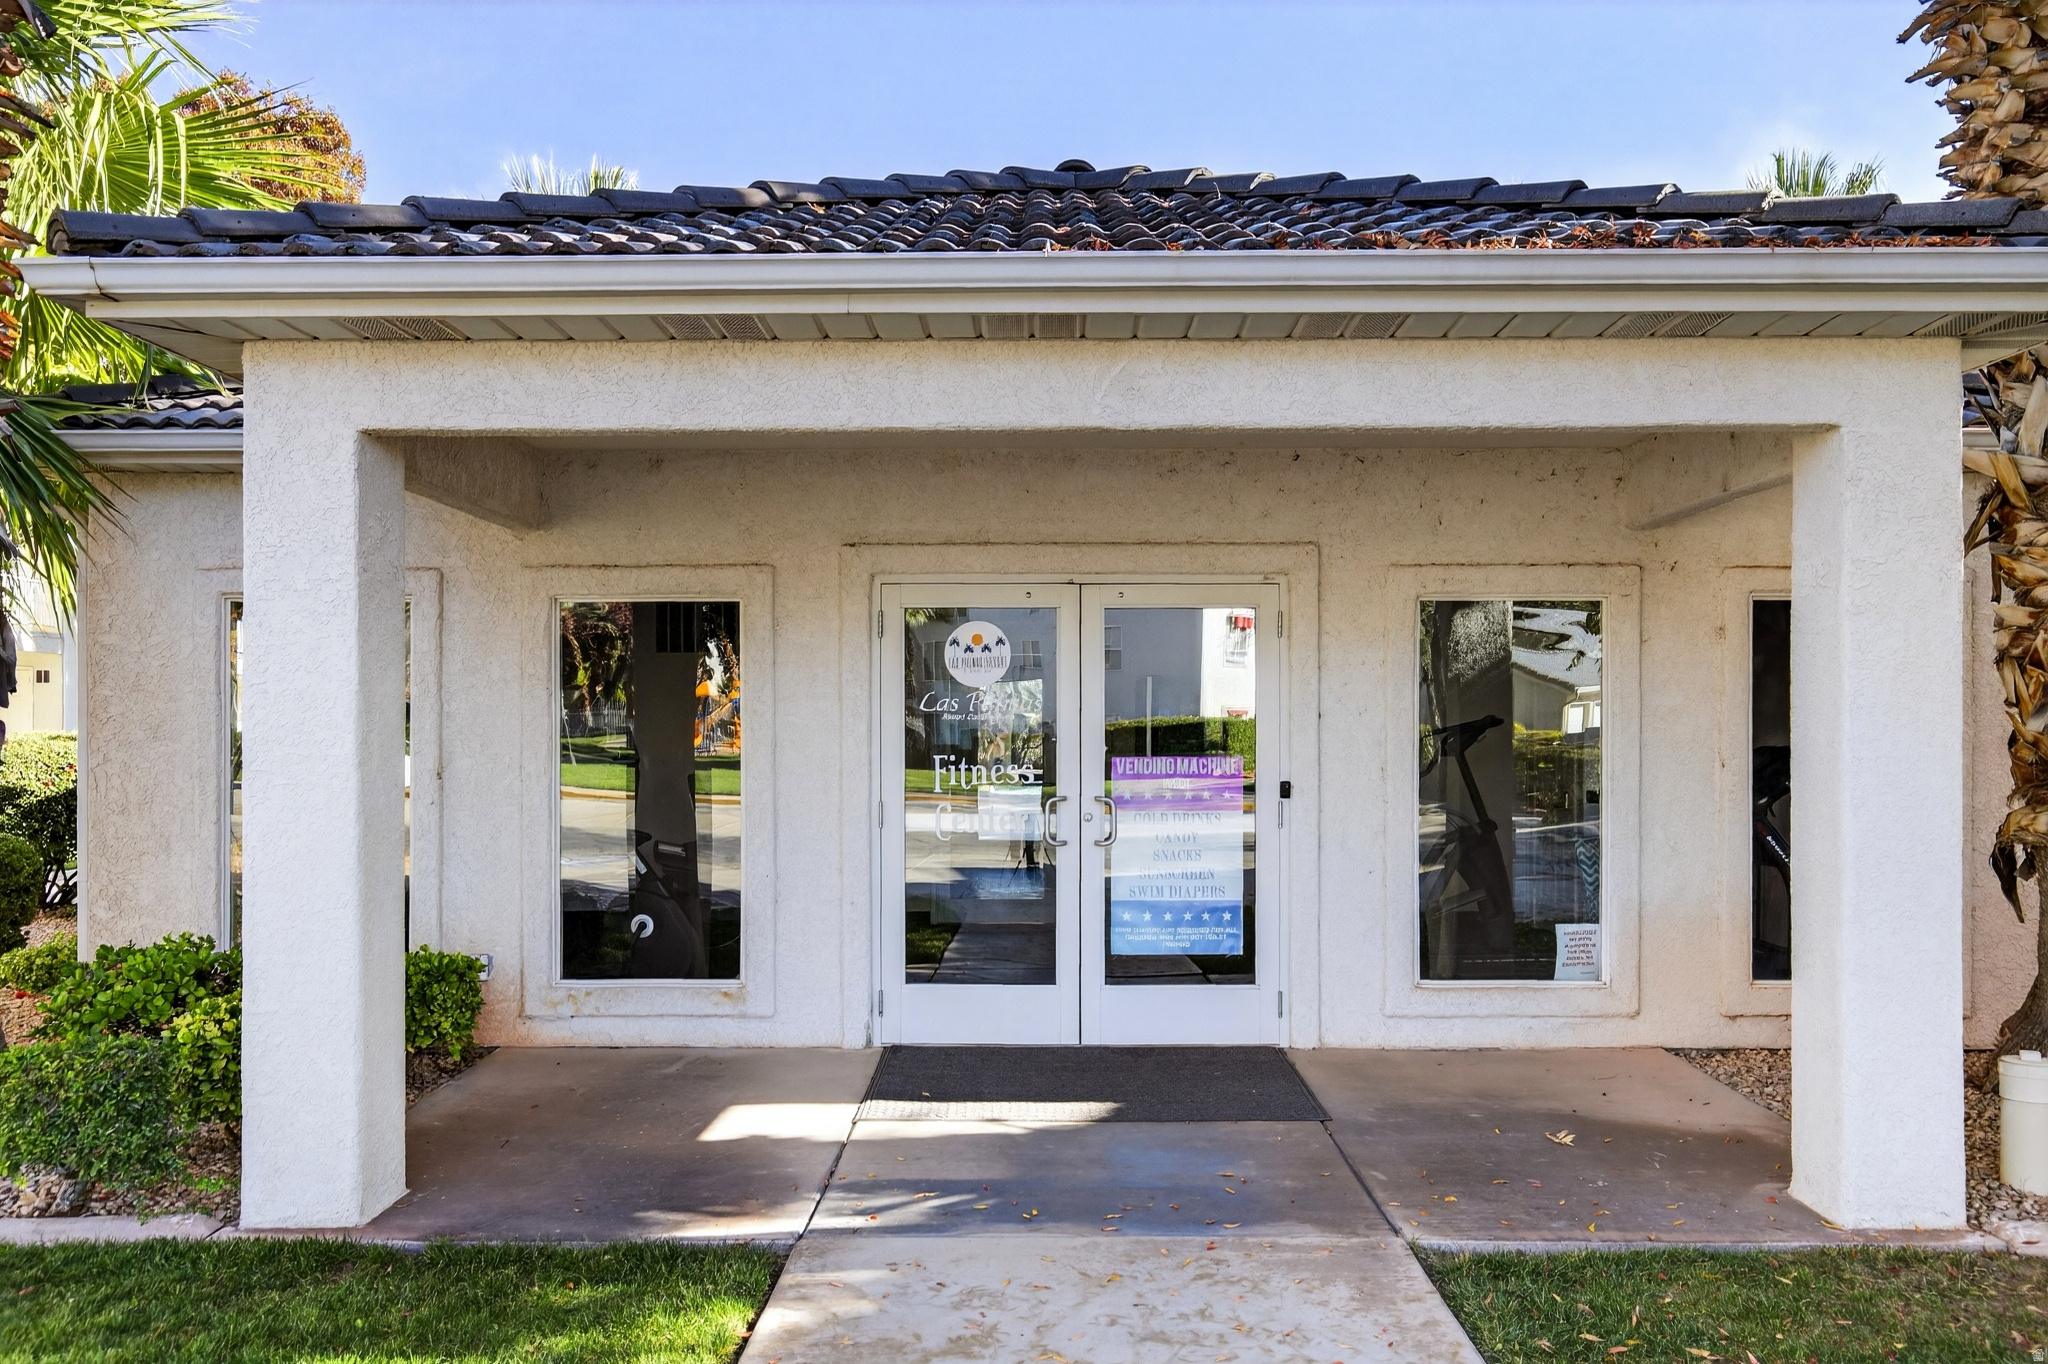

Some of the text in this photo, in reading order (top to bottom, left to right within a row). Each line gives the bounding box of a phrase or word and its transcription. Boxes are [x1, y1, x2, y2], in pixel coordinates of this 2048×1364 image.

[919, 691, 959, 711] Las
[933, 754, 1035, 792] Fitness
[1152, 848, 1202, 861] SNACKS
[1129, 885, 1226, 899] SWIM DIAPERS
